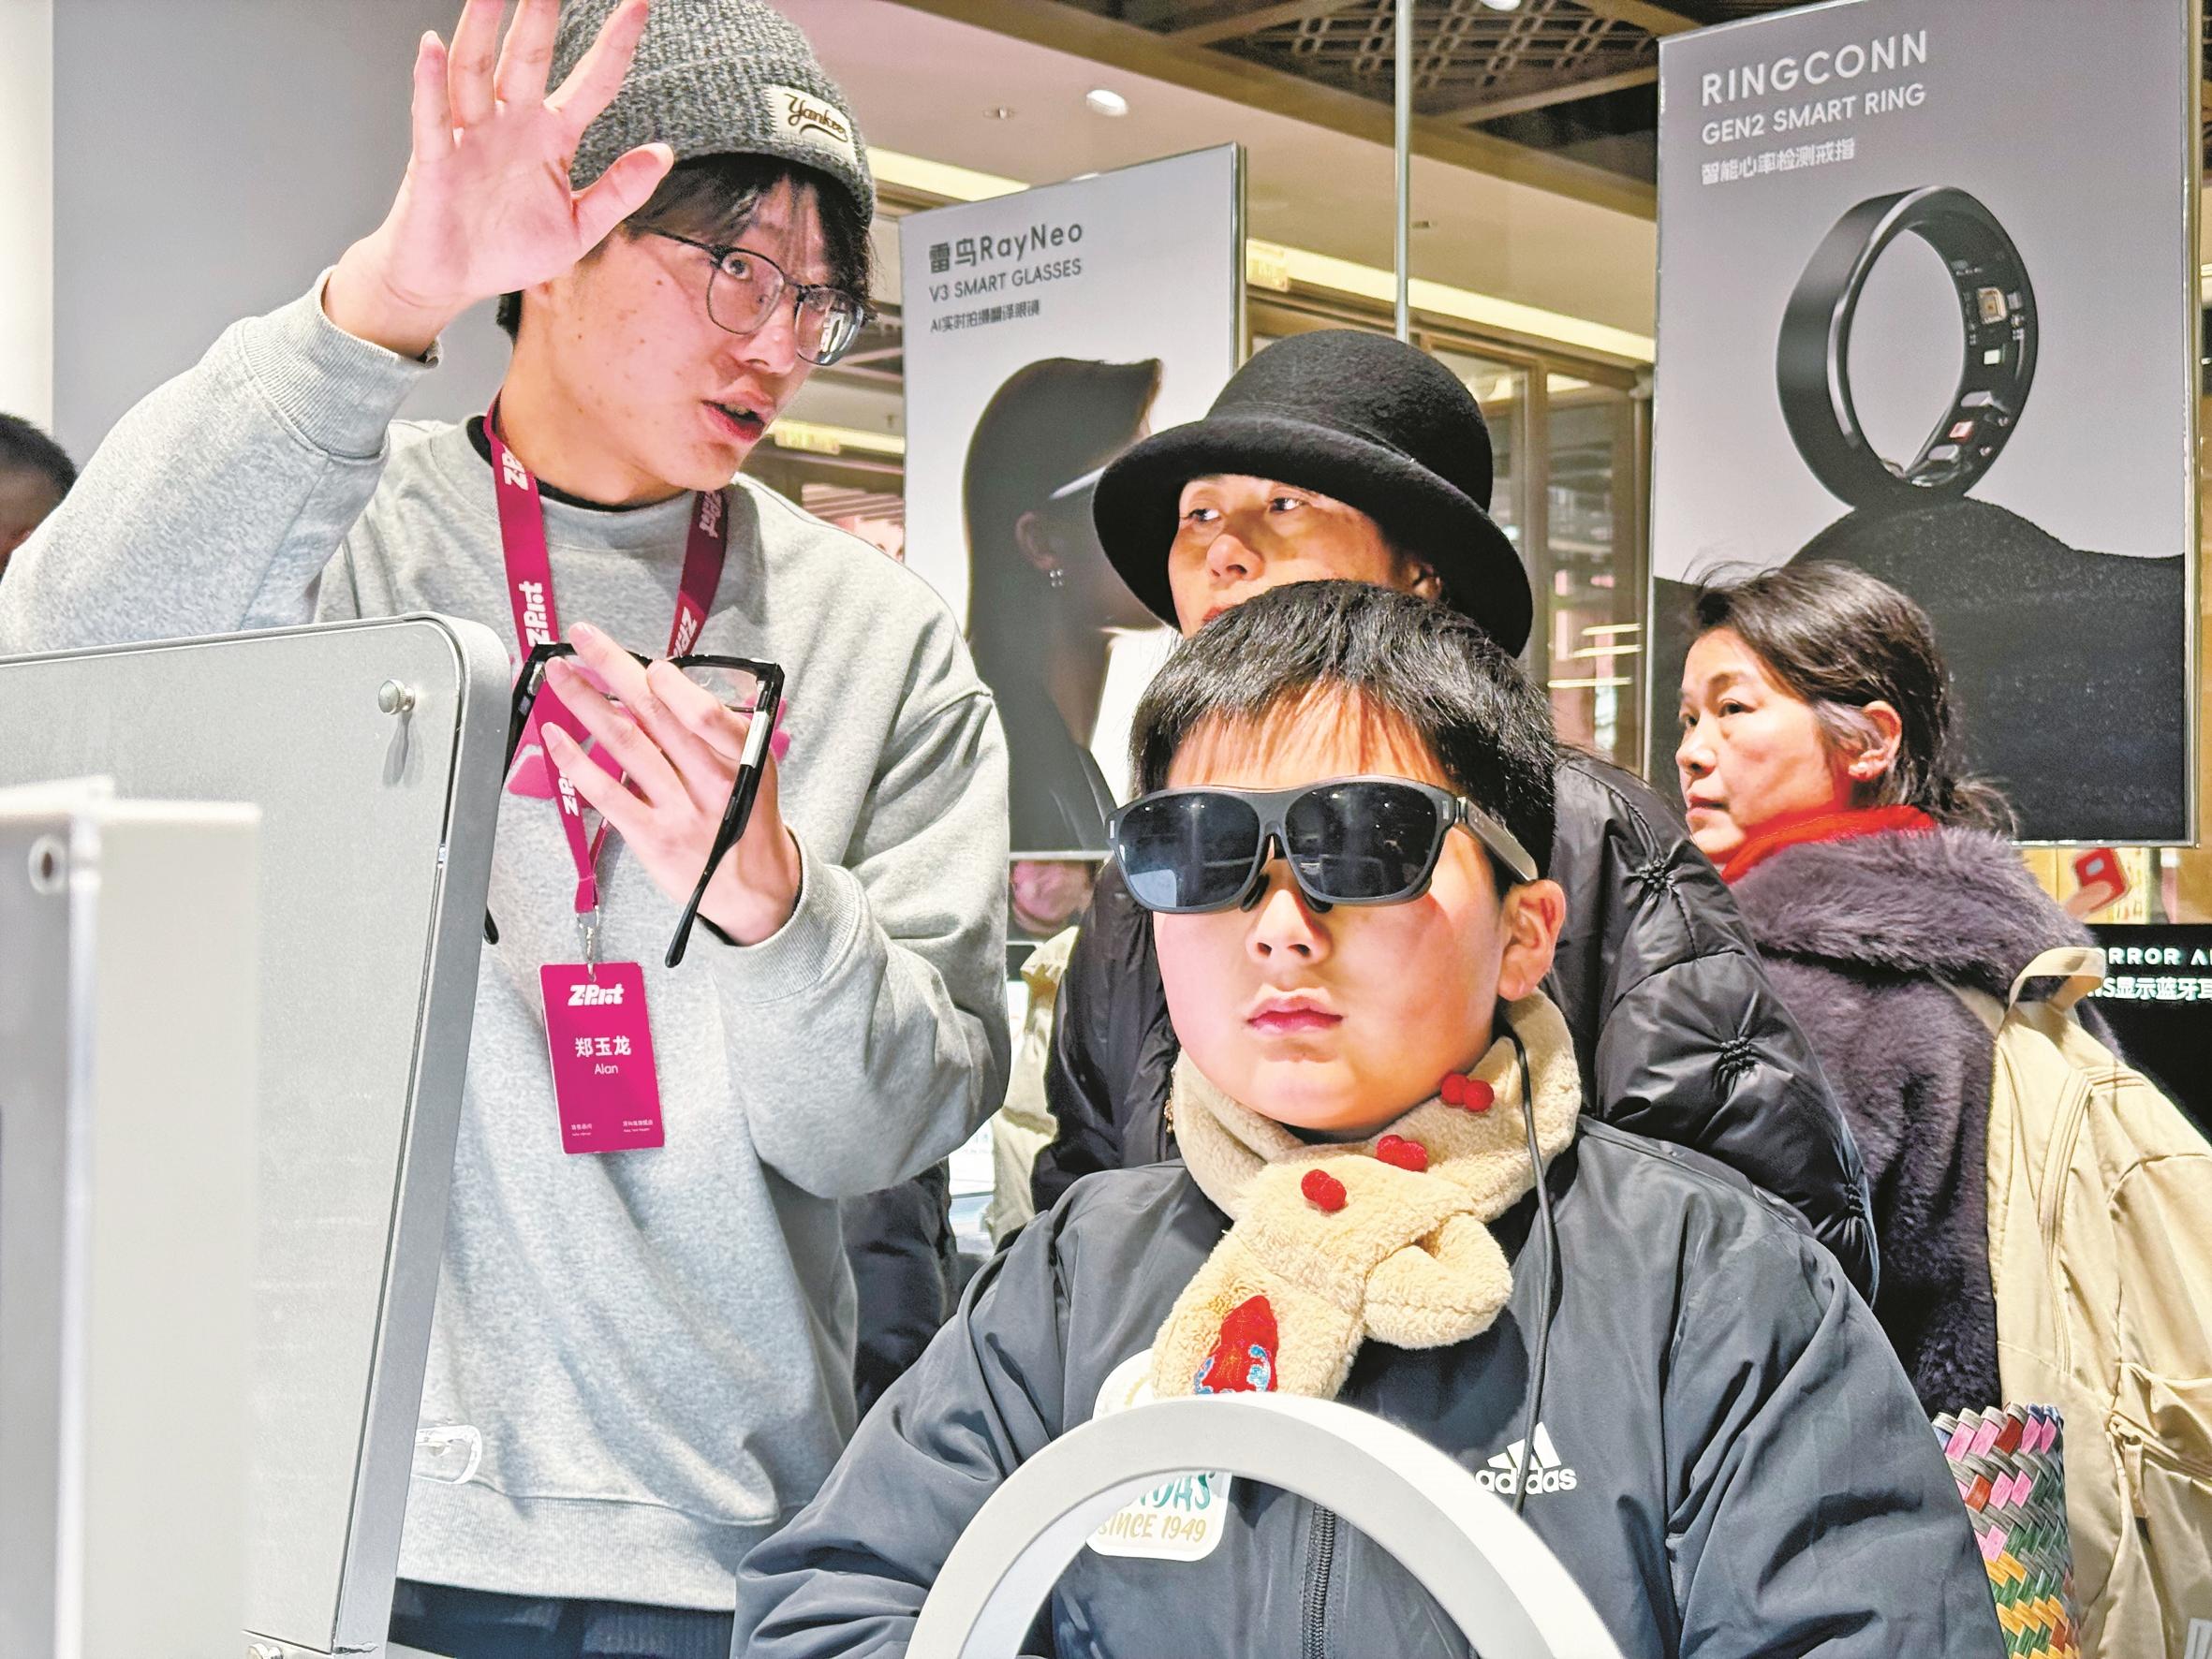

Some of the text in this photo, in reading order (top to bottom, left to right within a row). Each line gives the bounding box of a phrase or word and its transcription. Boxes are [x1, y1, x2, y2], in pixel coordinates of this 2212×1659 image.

[1702, 30, 1926, 107] RINGCONN
[1702, 82, 1926, 145] GEN2 SMART RING
[1702, 138, 1855, 185] 智能心率检测戒指
[929, 223, 1083, 274] 雷鸟RayNeo
[929, 258, 1082, 302] V3 SMART GLASSES
[2108, 947, 2181, 965] RROR
[575, 1035, 632, 1058] 郑玉龙
[594, 1064, 619, 1075] Alan
[1475, 1467, 1577, 1495] addas
[1160, 1515, 1207, 1544] 1949
